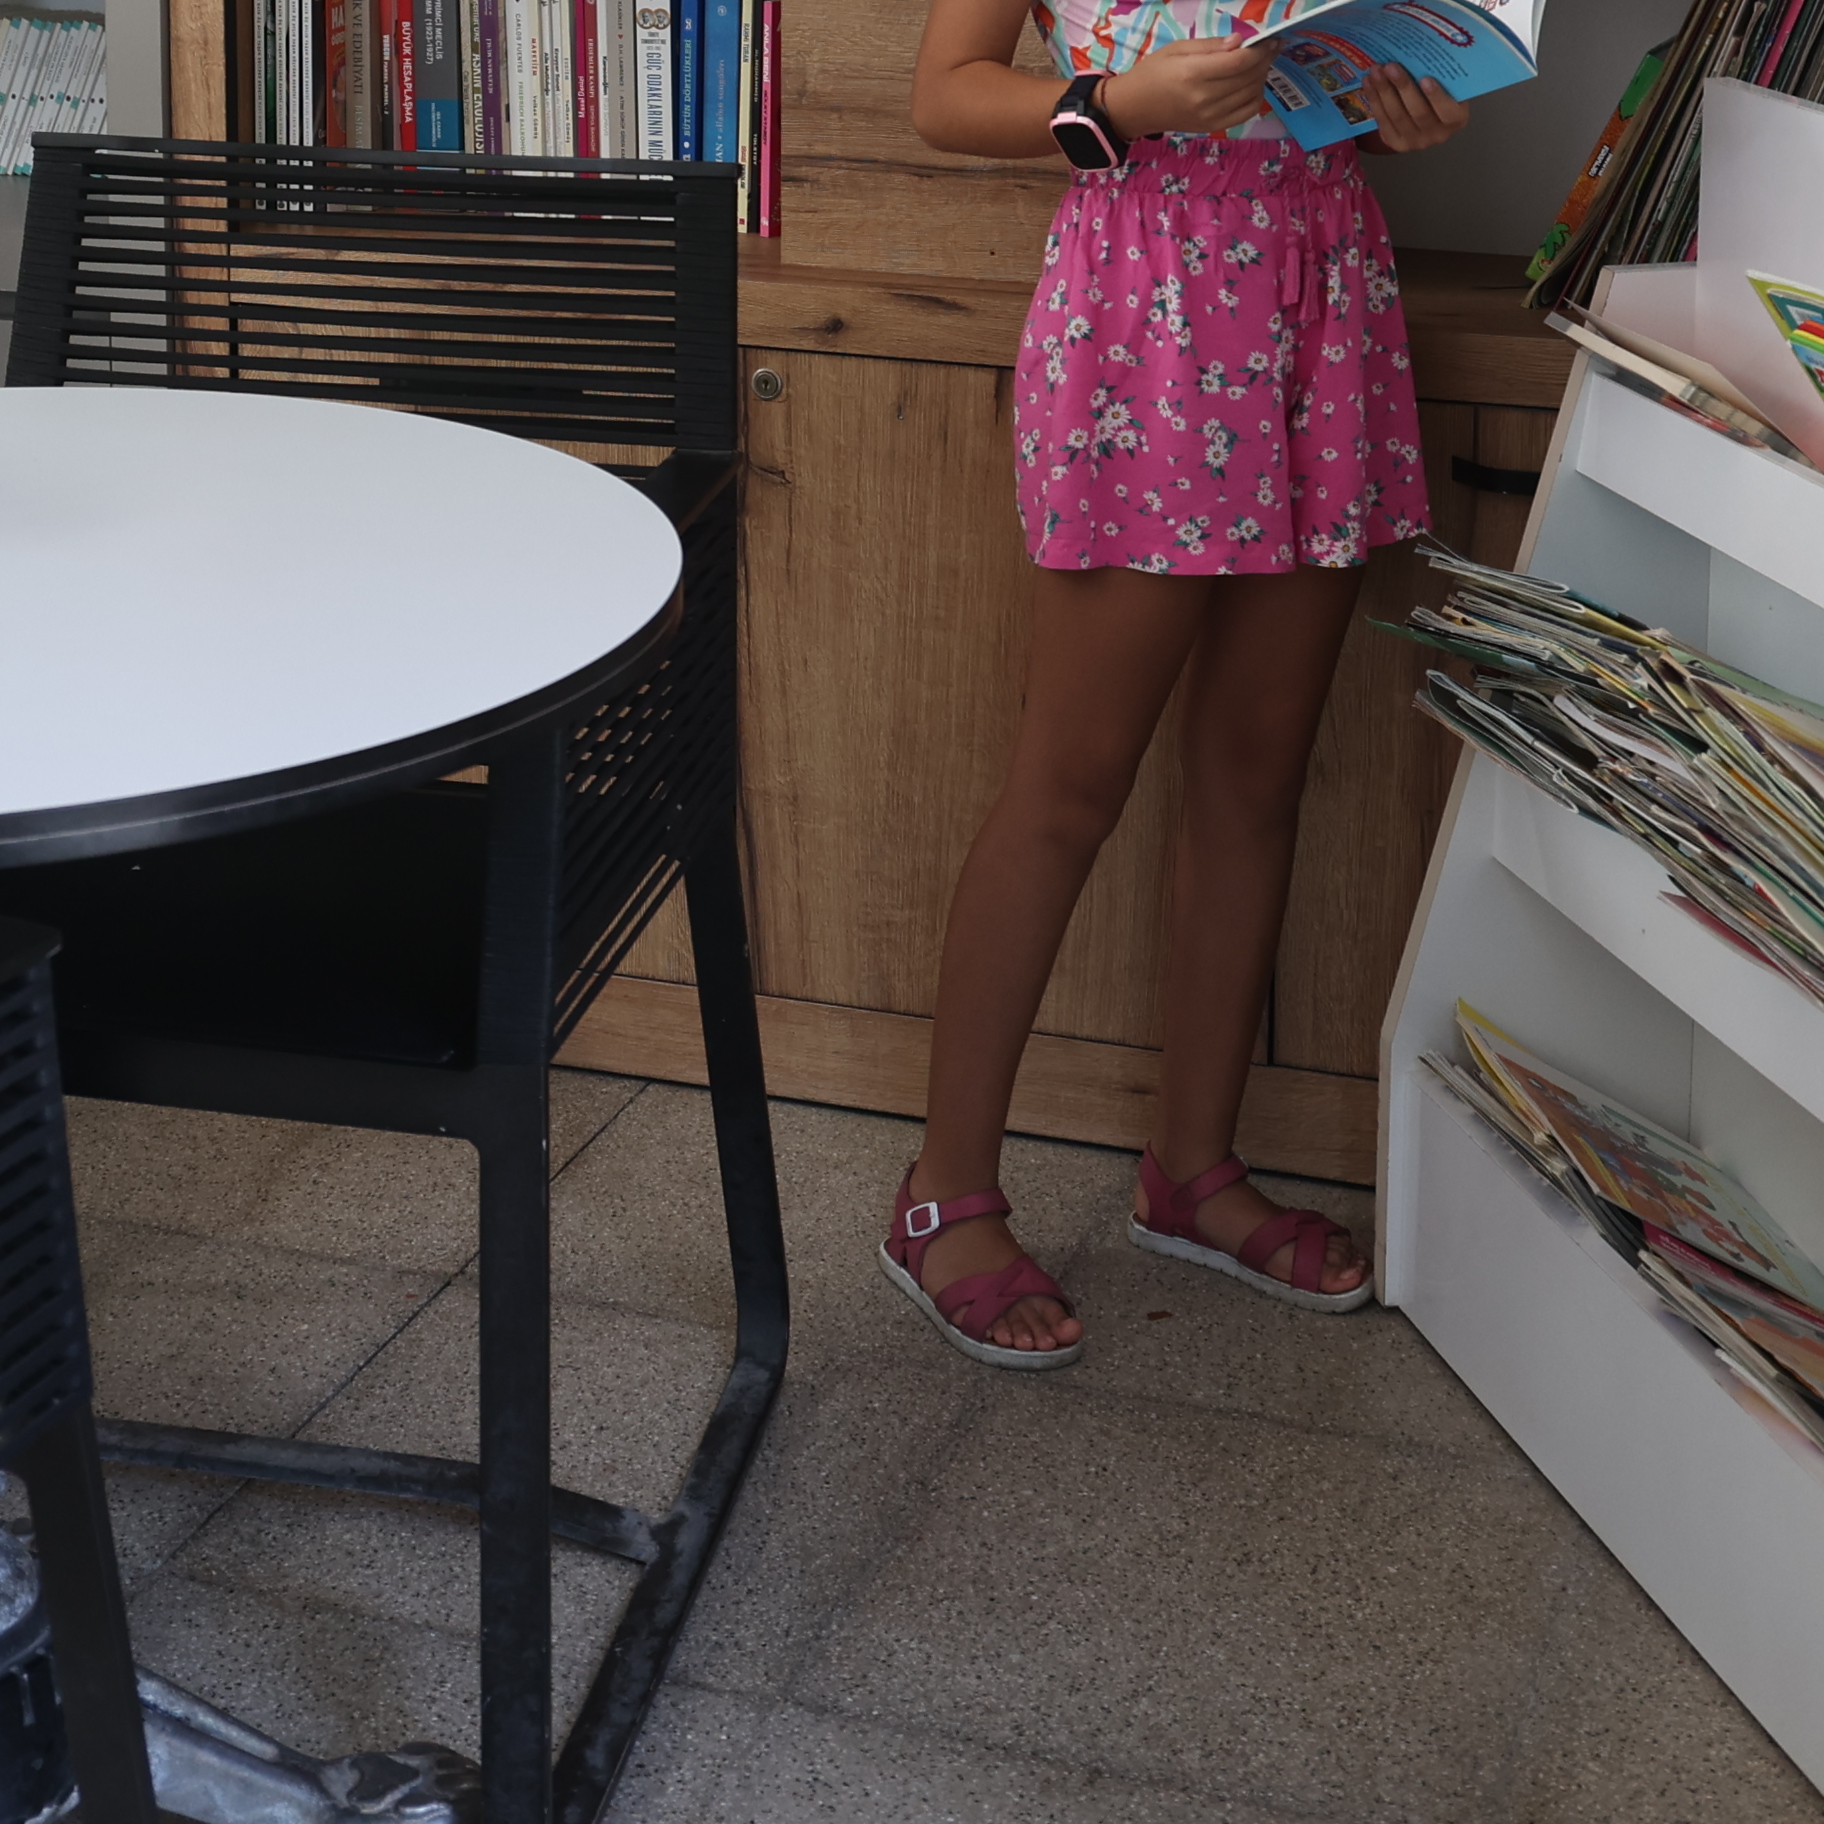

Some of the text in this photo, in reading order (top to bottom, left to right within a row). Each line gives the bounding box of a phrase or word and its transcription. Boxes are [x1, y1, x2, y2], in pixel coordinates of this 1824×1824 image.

[353, 13, 362, 28] VE
[401, 21, 413, 55] BÜYÜK
[424, 18, 434, 65] (1923-1927)
[353, 32, 364, 94] EDEBİYATI
[434, 27, 444, 60] MECLİS
[531, 37, 539, 76] MARKSİZM
[643, 52, 665, 71] GÜÇ
[763, 23, 771, 83] ANLA BENİ
[401, 57, 414, 123] HESAPLAŞMA
[486, 58, 495, 93] SÜLEYMAN
[681, 39, 692, 137] BÜTÜN DÖRTLÜKLERİ
[577, 76, 585, 118] Masal Denizi
[647, 73, 663, 136] ODAKLARININ
